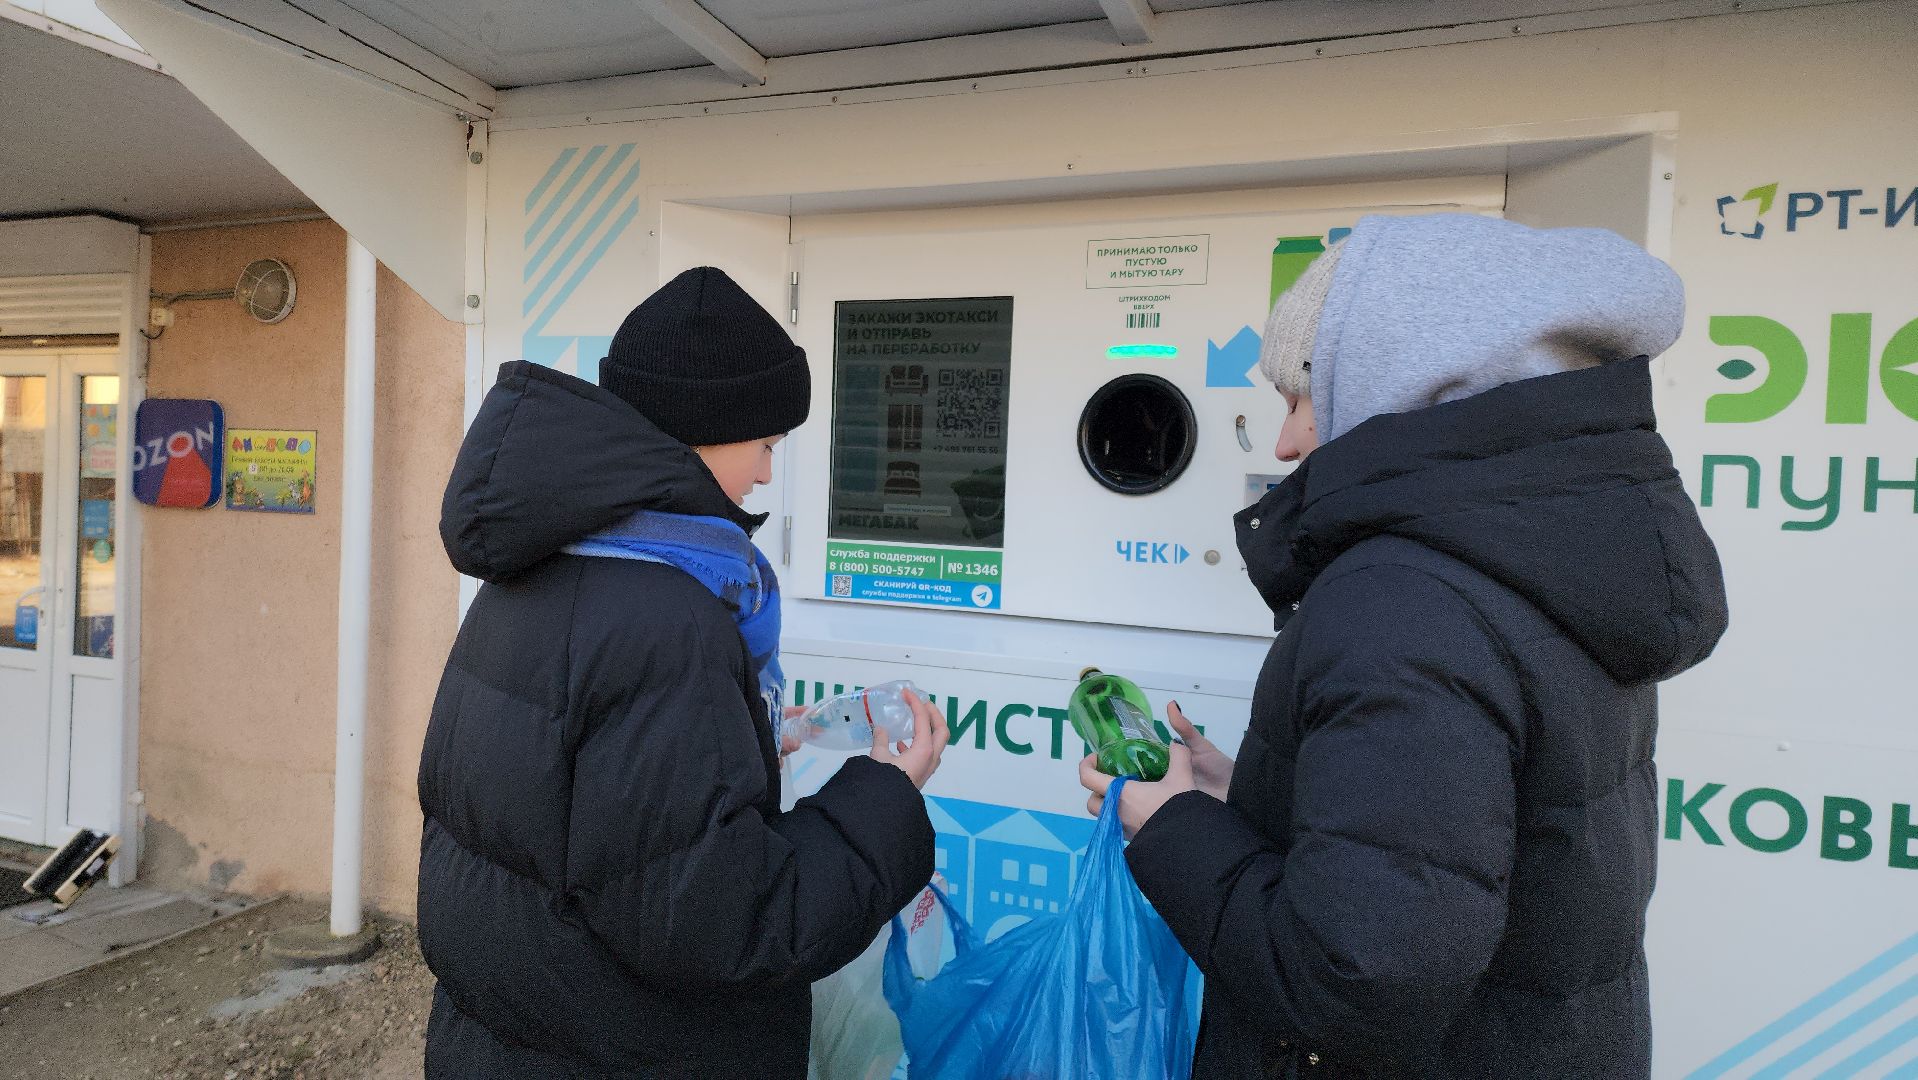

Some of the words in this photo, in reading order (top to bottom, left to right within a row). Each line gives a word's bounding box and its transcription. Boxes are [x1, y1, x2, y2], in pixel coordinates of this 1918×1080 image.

[1097, 246, 1156, 257] ПРИНИМАЮ
[1158, 244, 1198, 254] ТОЛЬКО
[1125, 257, 1167, 267] ПУСТУЮ
[1119, 269, 1158, 278] МЫТУЮ
[1160, 268, 1184, 277] ТАРУ
[1118, 294, 1171, 302] ШТРИХКОДОМ
[847, 311, 912, 325] ЗАКАЖИ
[915, 309, 999, 324] ЭКОТАКСИ
[847, 328, 857, 340] И
[861, 327, 932, 340] ОТПРАВЬ
[847, 343, 866, 355] НА
[871, 342, 981, 355] ПЕРЕРАБОТКУ
[829, 548, 870, 563] служба
[873, 552, 936, 564] поддержки
[1116, 540, 1168, 564] ЧЕК
[829, 561, 836, 570] 8
[839, 562, 869, 574] (800)
[872, 563, 925, 577] 500-5747
[873, 579, 917, 591] СКАНИРУЙ
[918, 582, 952, 594] QR-КОД
[888, 591, 925, 600] поддержки
[932, 593, 962, 603] telegram
